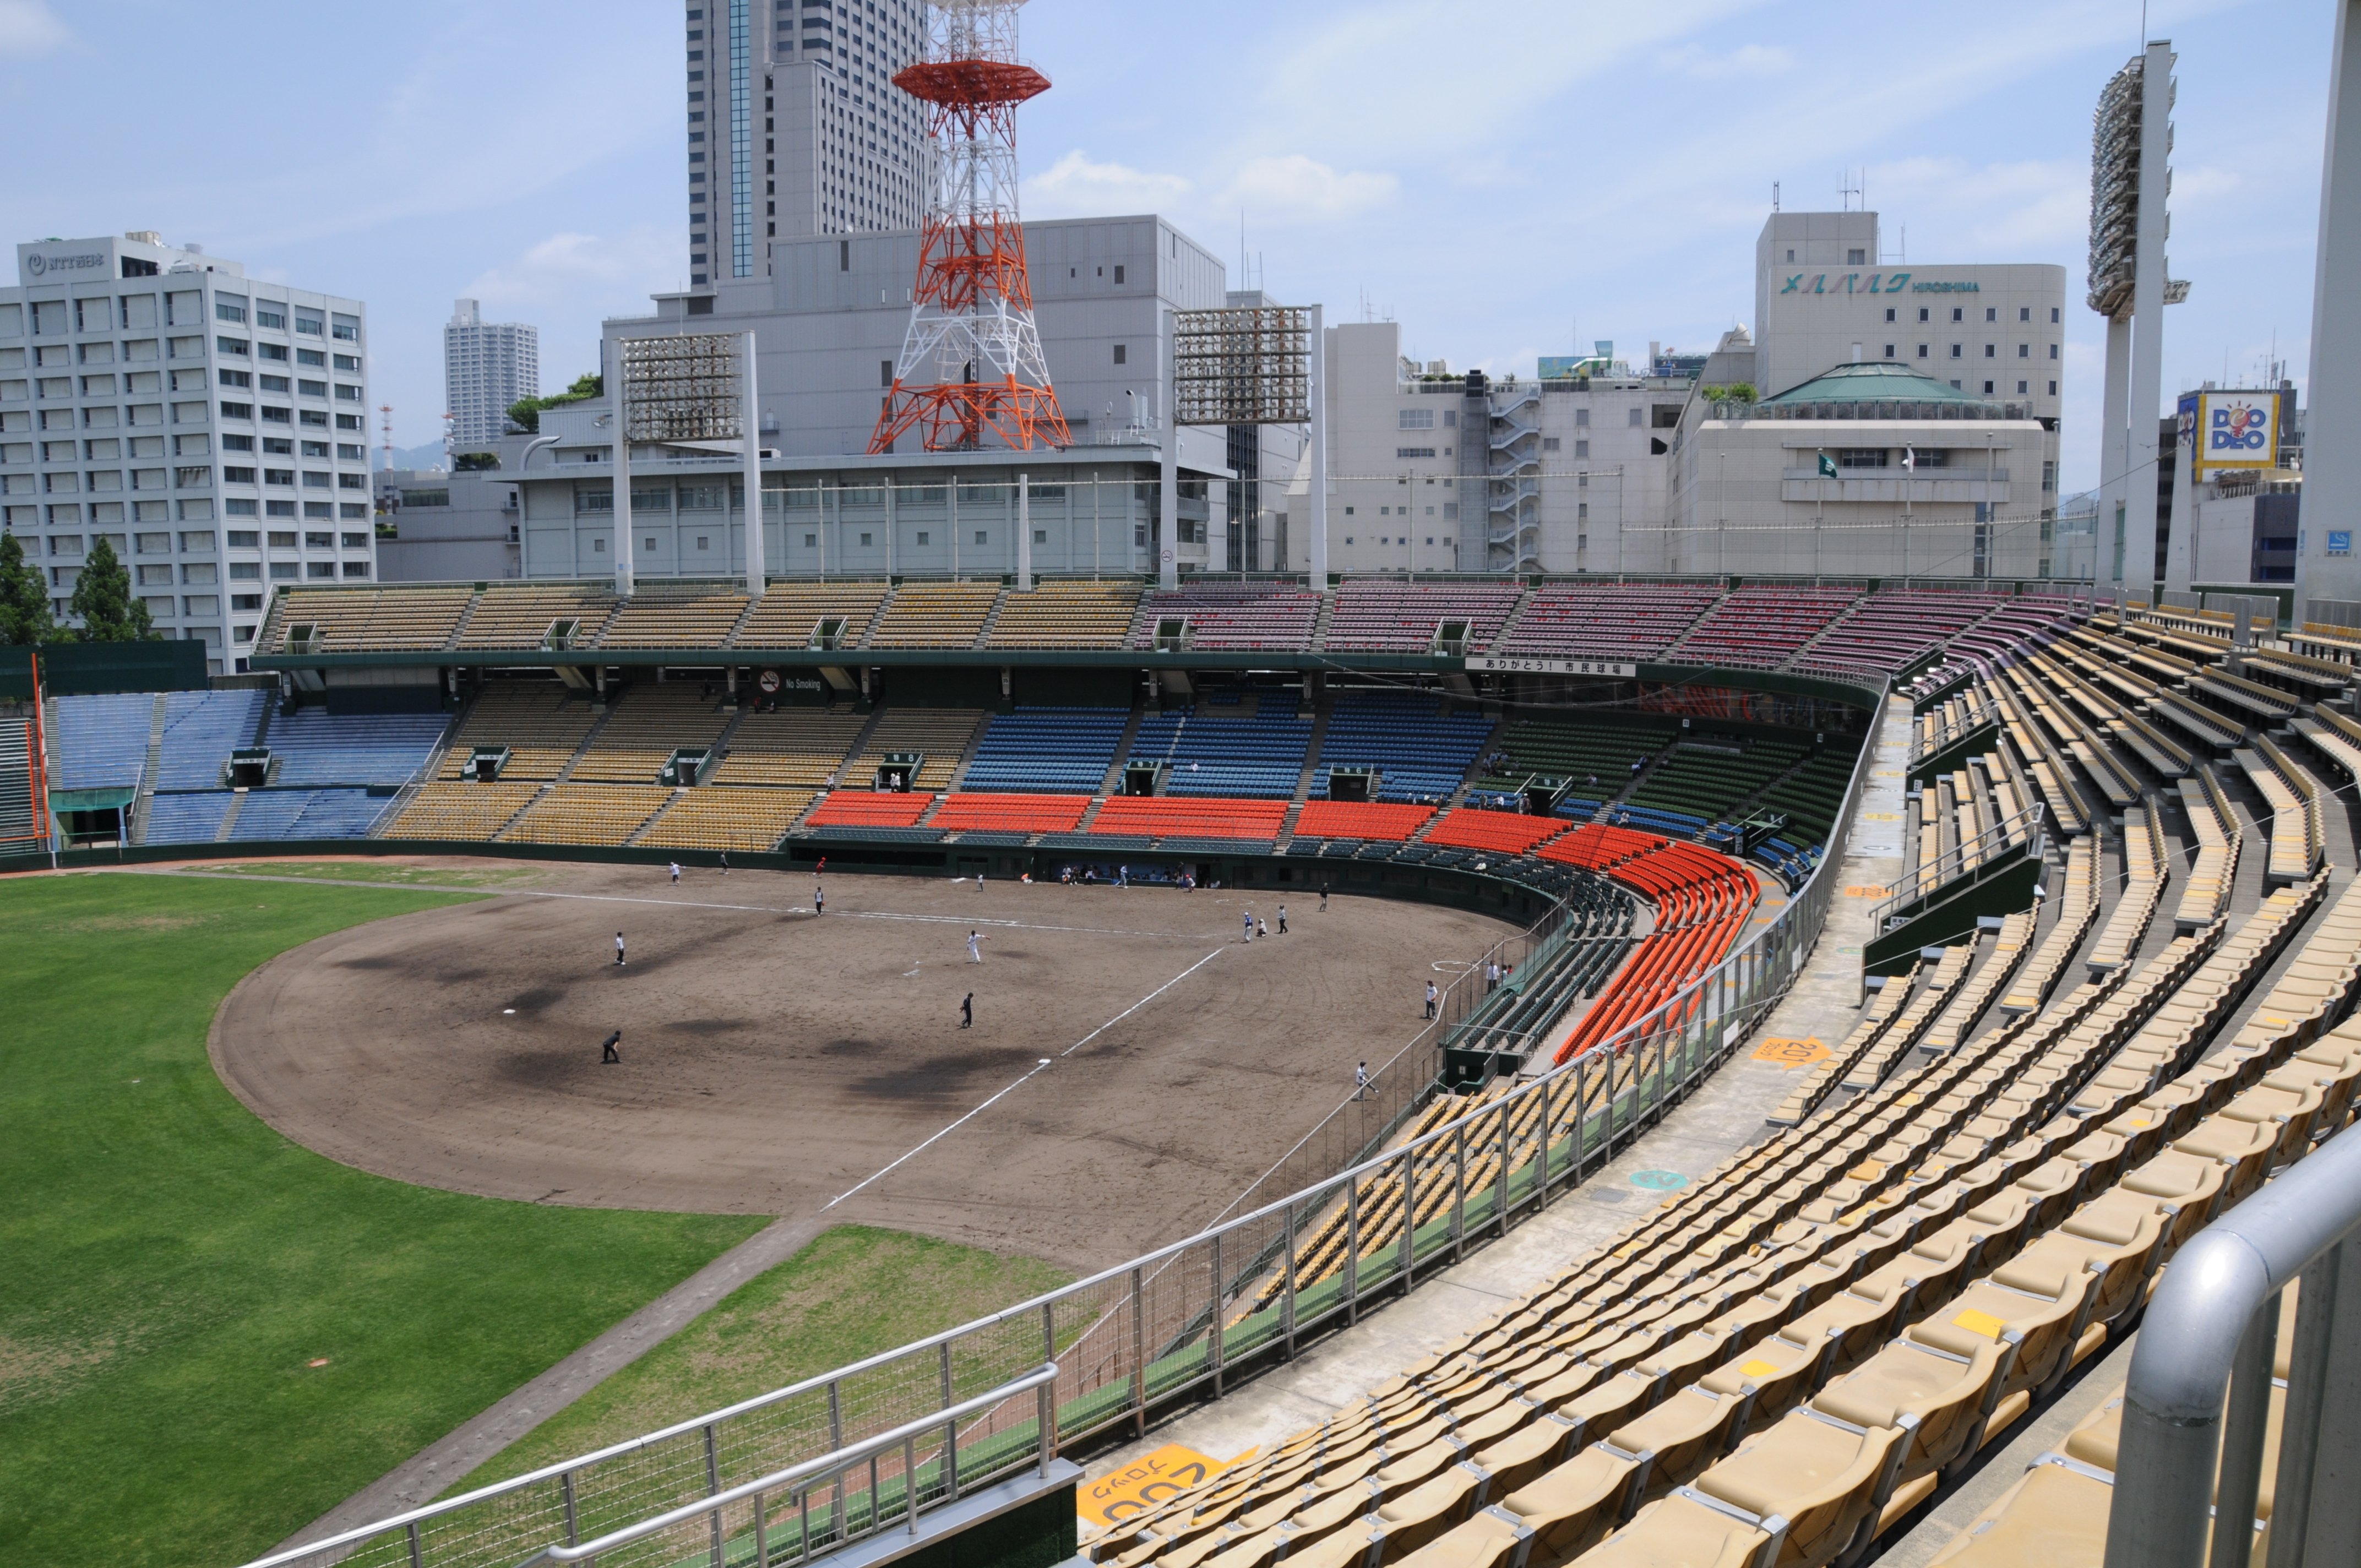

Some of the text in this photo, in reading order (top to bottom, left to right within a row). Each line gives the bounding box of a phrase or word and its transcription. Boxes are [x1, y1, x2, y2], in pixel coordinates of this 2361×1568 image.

[1781, 273, 1979, 293] メルパルク HIROSHIMA
[1565, 662, 1621, 674] 市民球場
[786, 679, 820, 691] No Smoking
[1776, 1042, 1818, 1063] 201
[1092, 1460, 1168, 1499] ブロック
